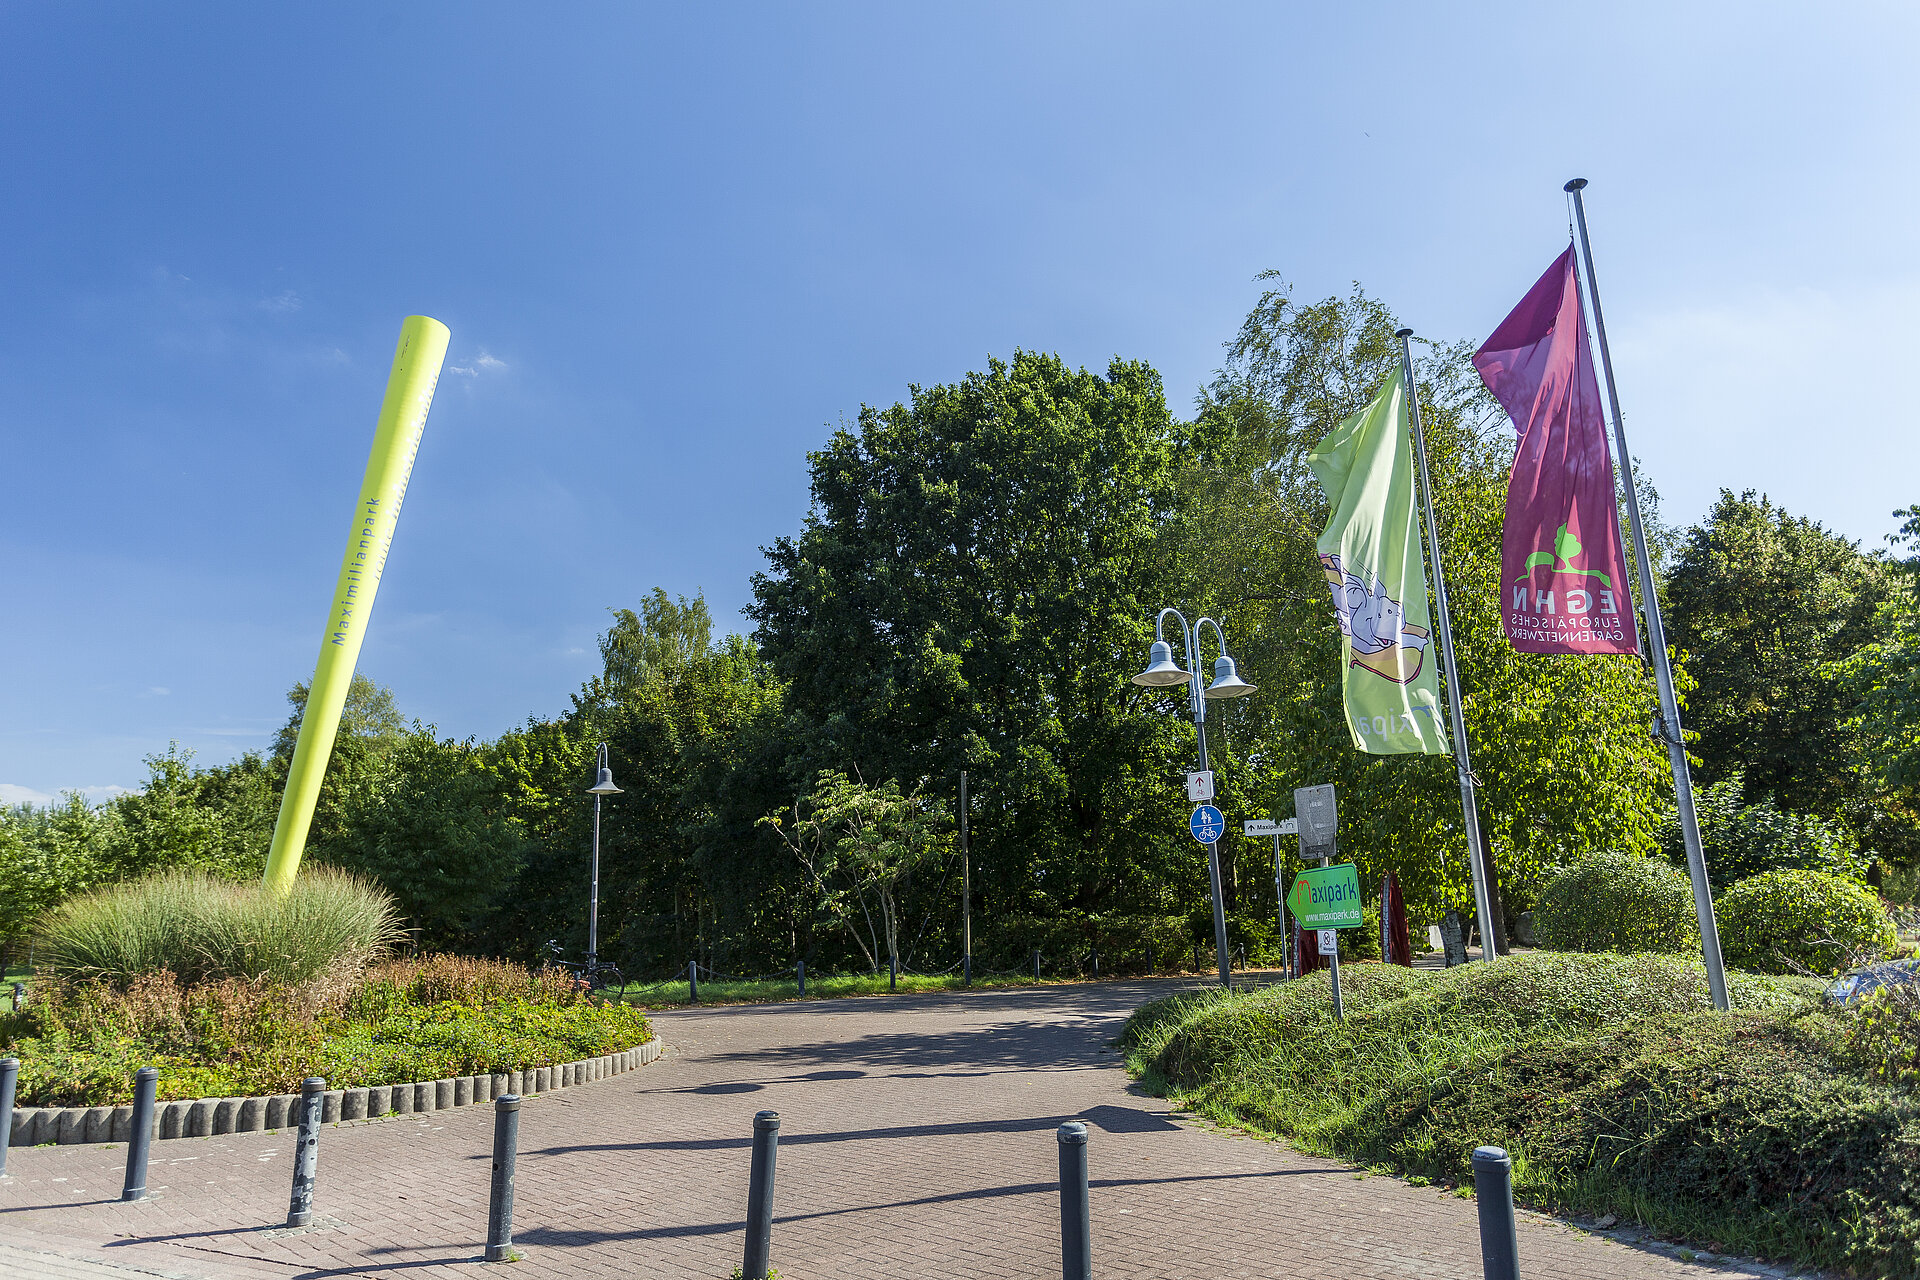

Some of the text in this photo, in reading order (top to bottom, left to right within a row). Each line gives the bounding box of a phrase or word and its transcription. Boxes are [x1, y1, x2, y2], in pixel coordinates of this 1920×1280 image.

[331, 497, 380, 647] Maximilianpark
[1297, 876, 1357, 908] Maxipark
[1305, 908, 1360, 923] www.maxipark.de
